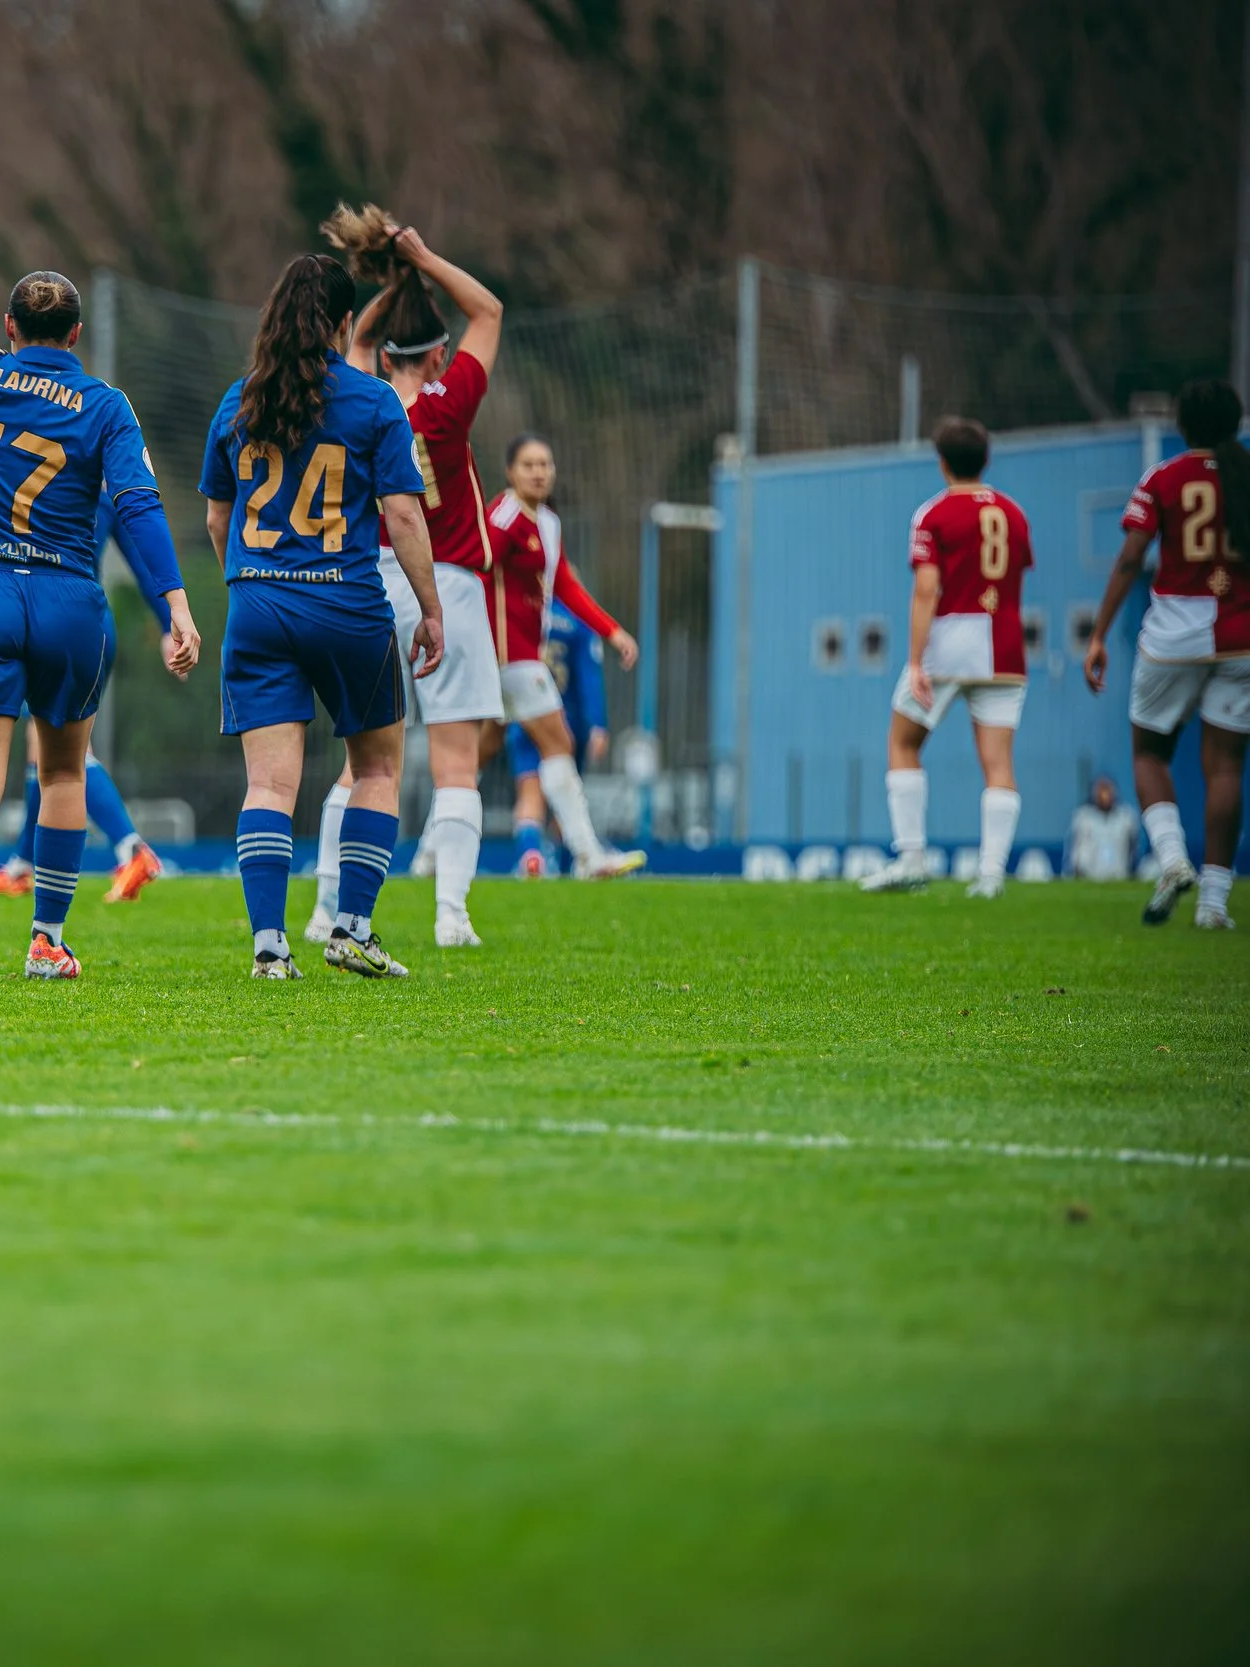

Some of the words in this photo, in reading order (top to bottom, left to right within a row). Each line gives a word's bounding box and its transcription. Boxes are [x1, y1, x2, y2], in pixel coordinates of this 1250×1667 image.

[238, 442, 347, 553] 24
[1181, 480, 1243, 563] 2
[978, 504, 1009, 580] 8
